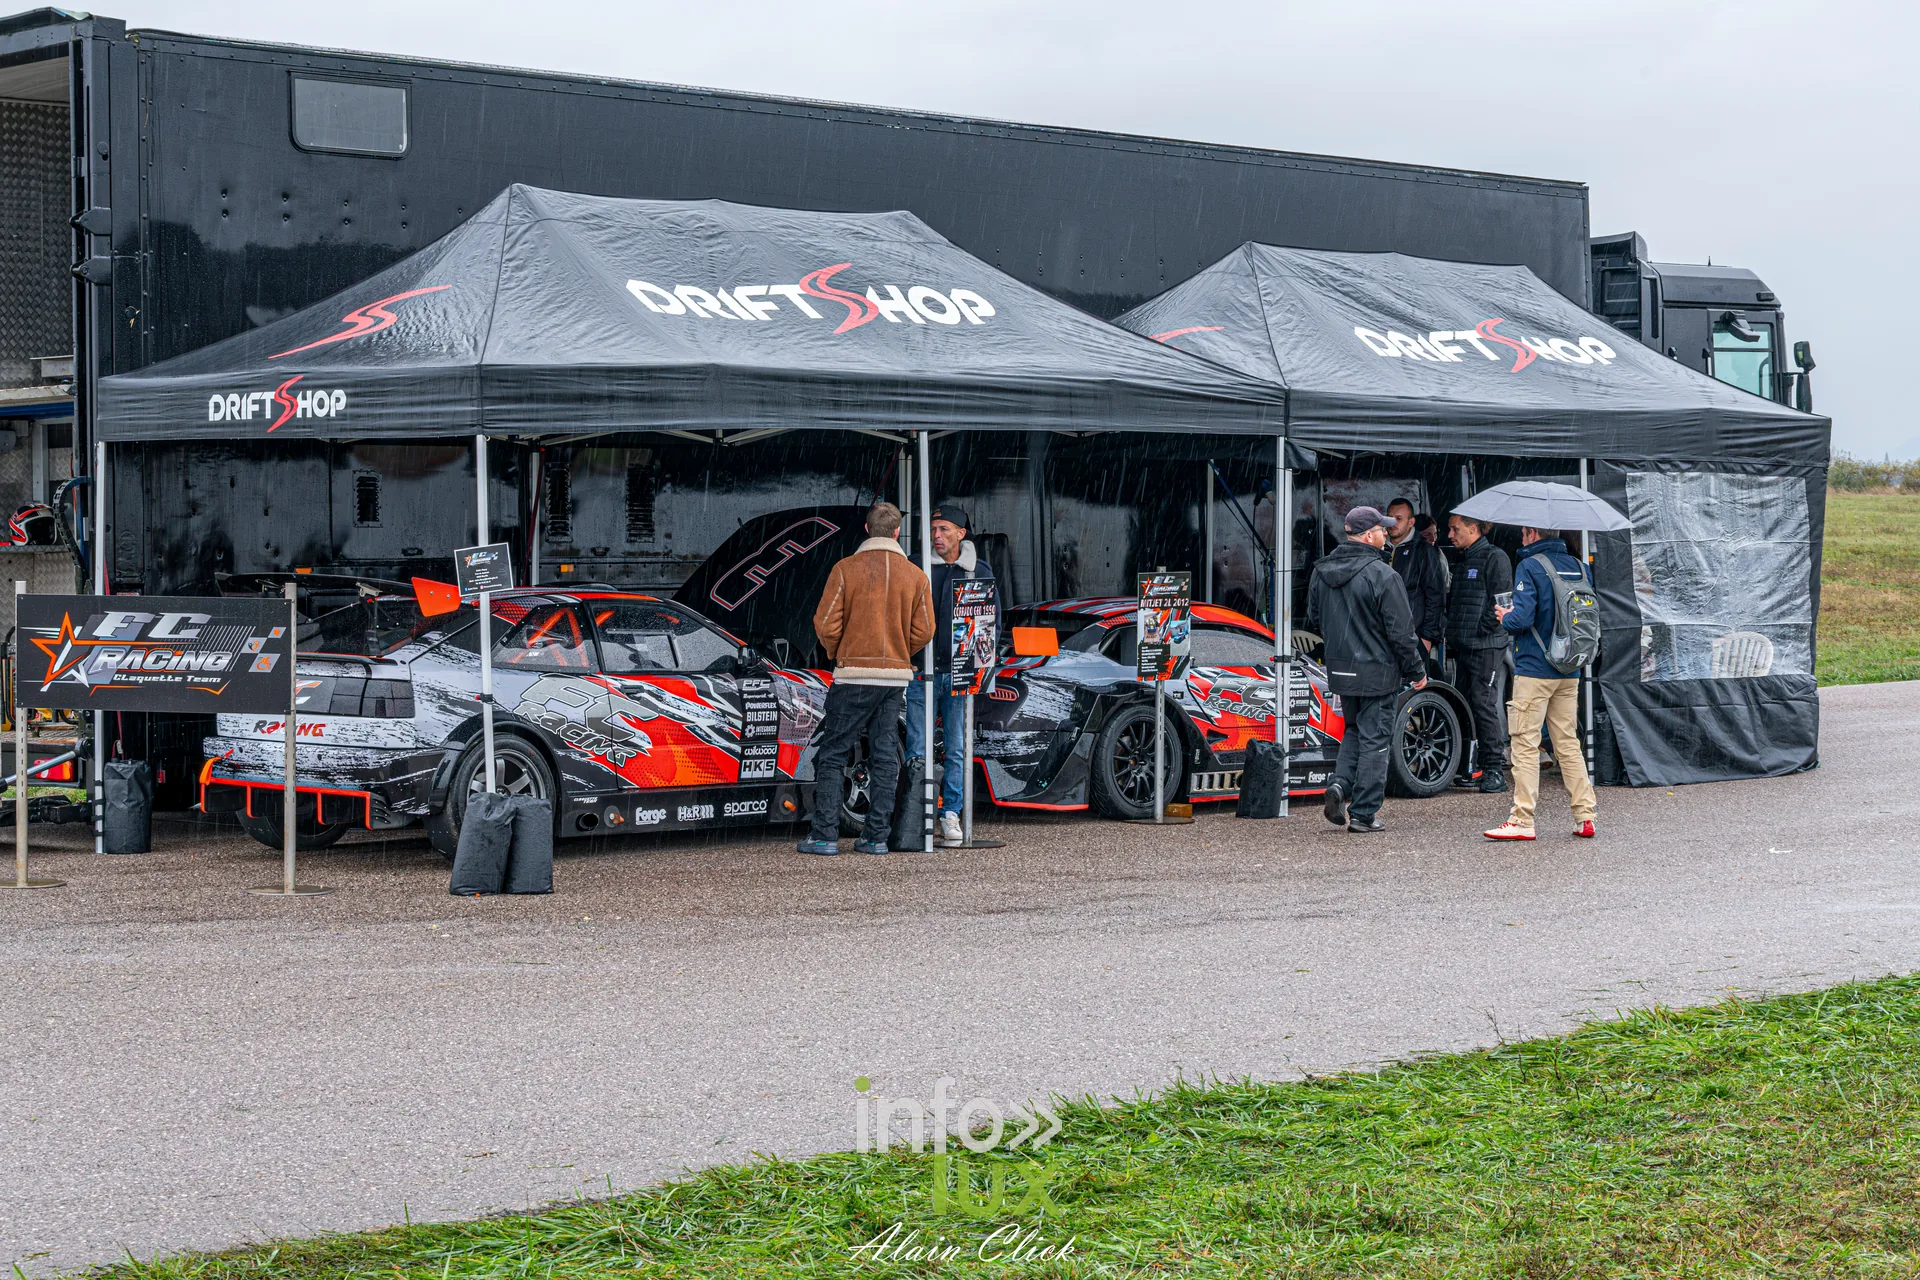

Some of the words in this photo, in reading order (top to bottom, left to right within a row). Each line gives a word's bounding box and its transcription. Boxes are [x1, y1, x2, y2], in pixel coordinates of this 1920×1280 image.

[1140, 599, 1163, 608] MITJET
[1163, 599, 1172, 608] 2L
[1172, 598, 1190, 607] 2012
[92, 611, 213, 639] FC
[186, 675, 222, 683] Team
[742, 679, 771, 690] PFC
[746, 711, 778, 722] BILSTEIN
[744, 745, 777, 756] wilwood
[742, 759, 775, 774] HKS
[677, 805, 701, 822] H&R
[723, 799, 767, 817] sparco
